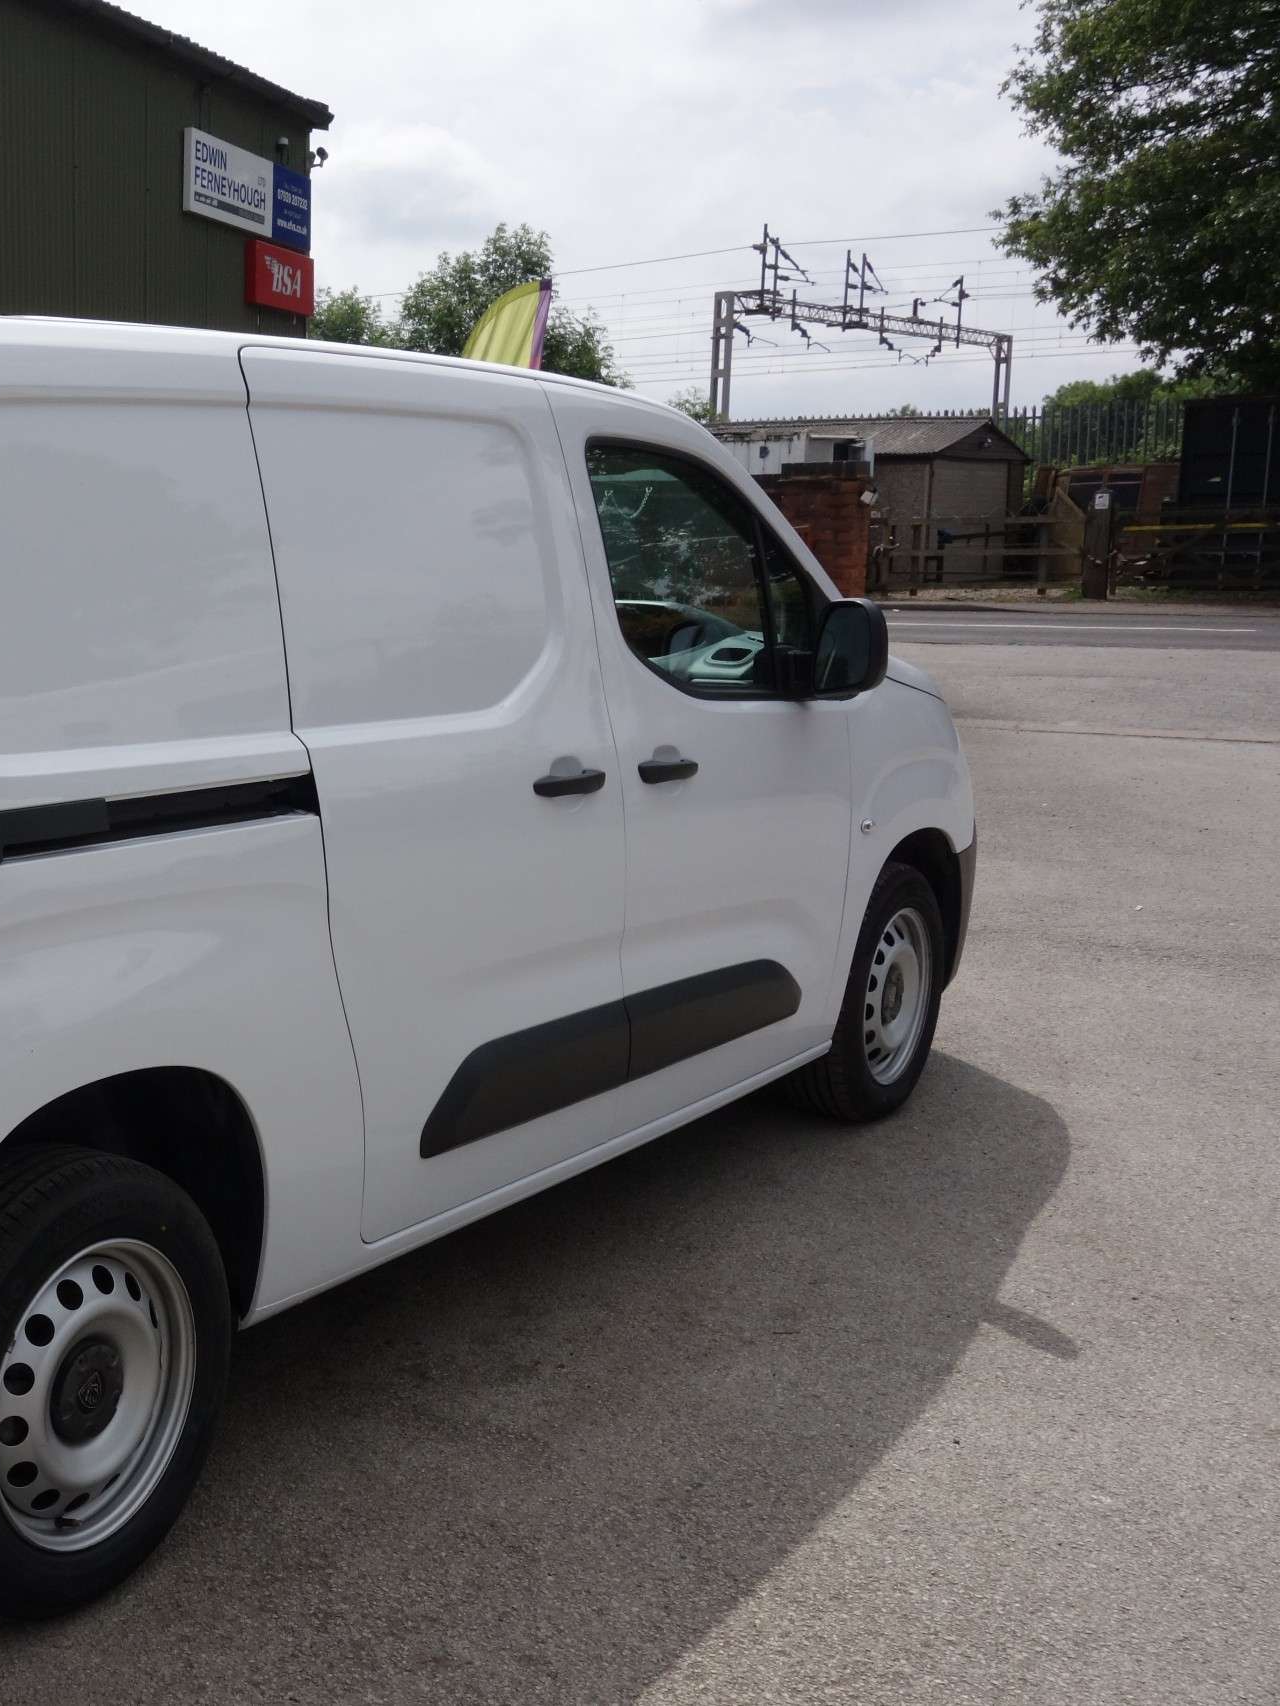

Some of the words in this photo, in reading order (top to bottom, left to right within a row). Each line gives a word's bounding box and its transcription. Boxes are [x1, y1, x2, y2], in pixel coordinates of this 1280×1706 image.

[195, 140, 227, 172] EDWIN
[194, 166, 266, 211] FERNEYHOUGH
[271, 262, 302, 298] BSA
